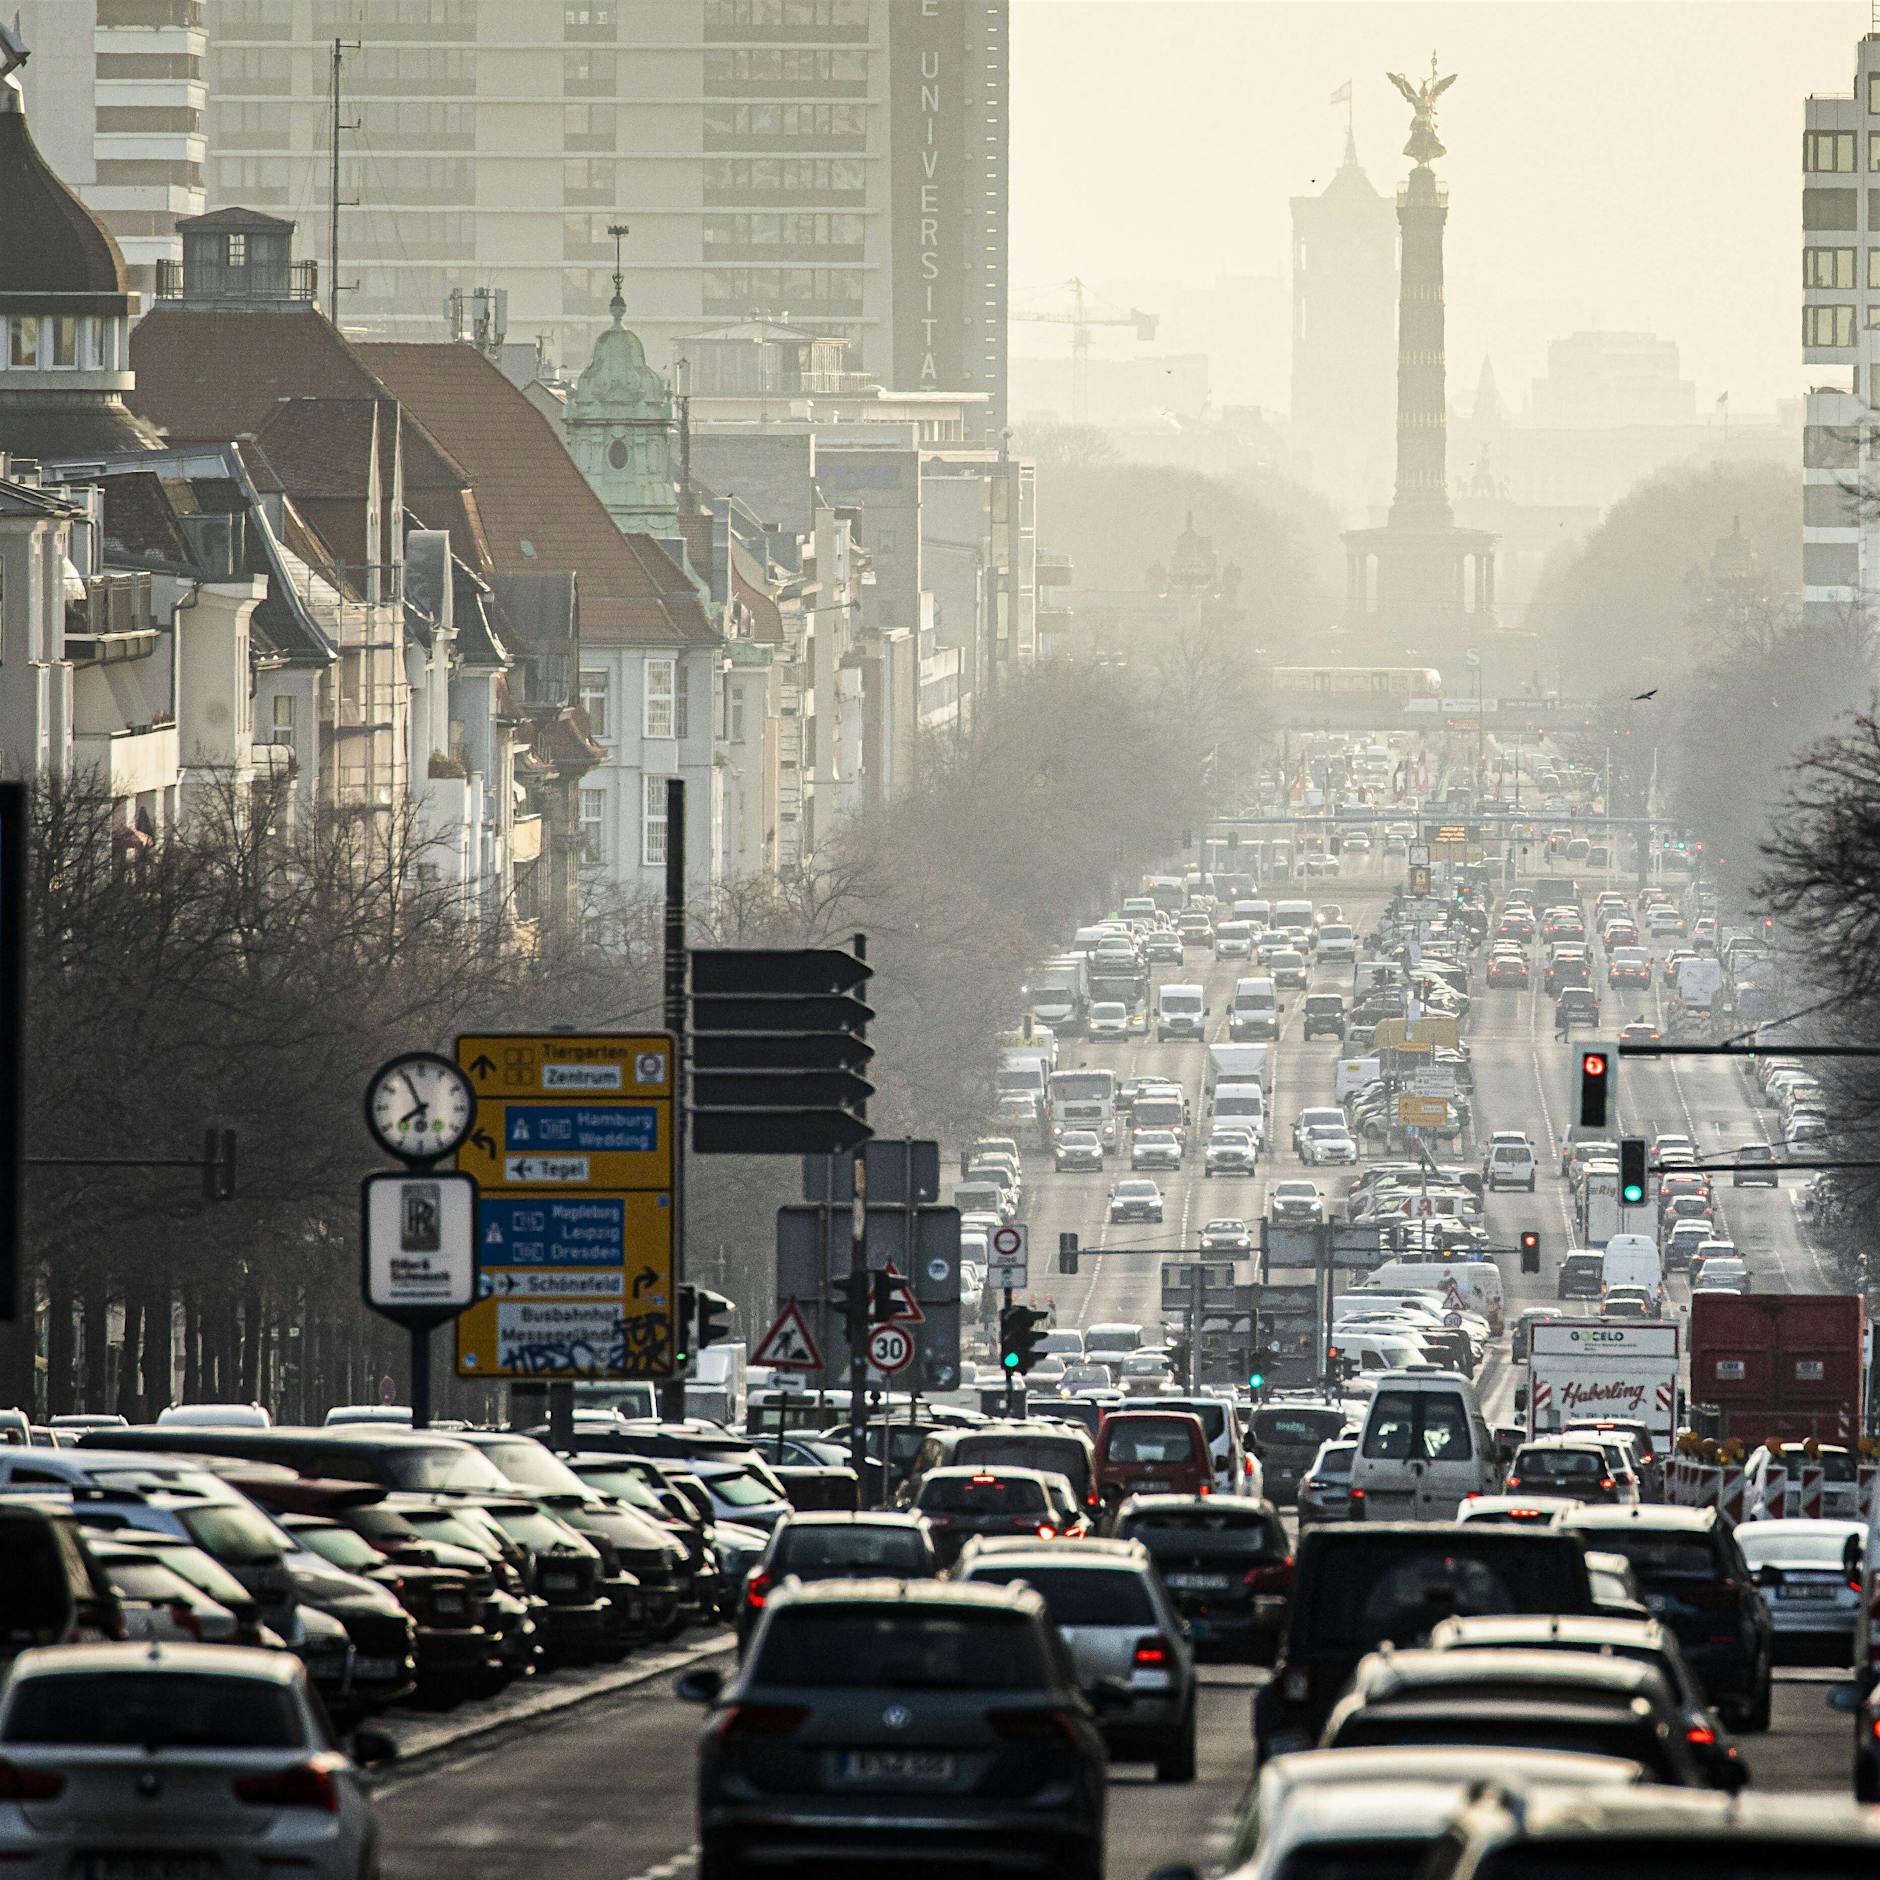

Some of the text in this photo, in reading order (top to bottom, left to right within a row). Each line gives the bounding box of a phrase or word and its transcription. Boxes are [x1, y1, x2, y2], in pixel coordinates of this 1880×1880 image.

[921, 52, 939, 390] UNIVERSITÄ
[544, 1043, 628, 1062] Tiergarten
[548, 1068, 618, 1085] Zentrum
[577, 1113, 652, 1130] Hamburg
[579, 1131, 649, 1150] Wedding
[541, 1161, 585, 1180] Tegel
[552, 1204, 620, 1222] Magdeburg
[562, 1224, 620, 1242] Leipzig
[551, 1244, 620, 1260] Dresden
[528, 1274, 620, 1292] Schönefeld
[521, 1306, 619, 1323] Busbahnhof
[874, 1338, 903, 1360] 30
[1560, 1381, 1647, 1410] Haberling
